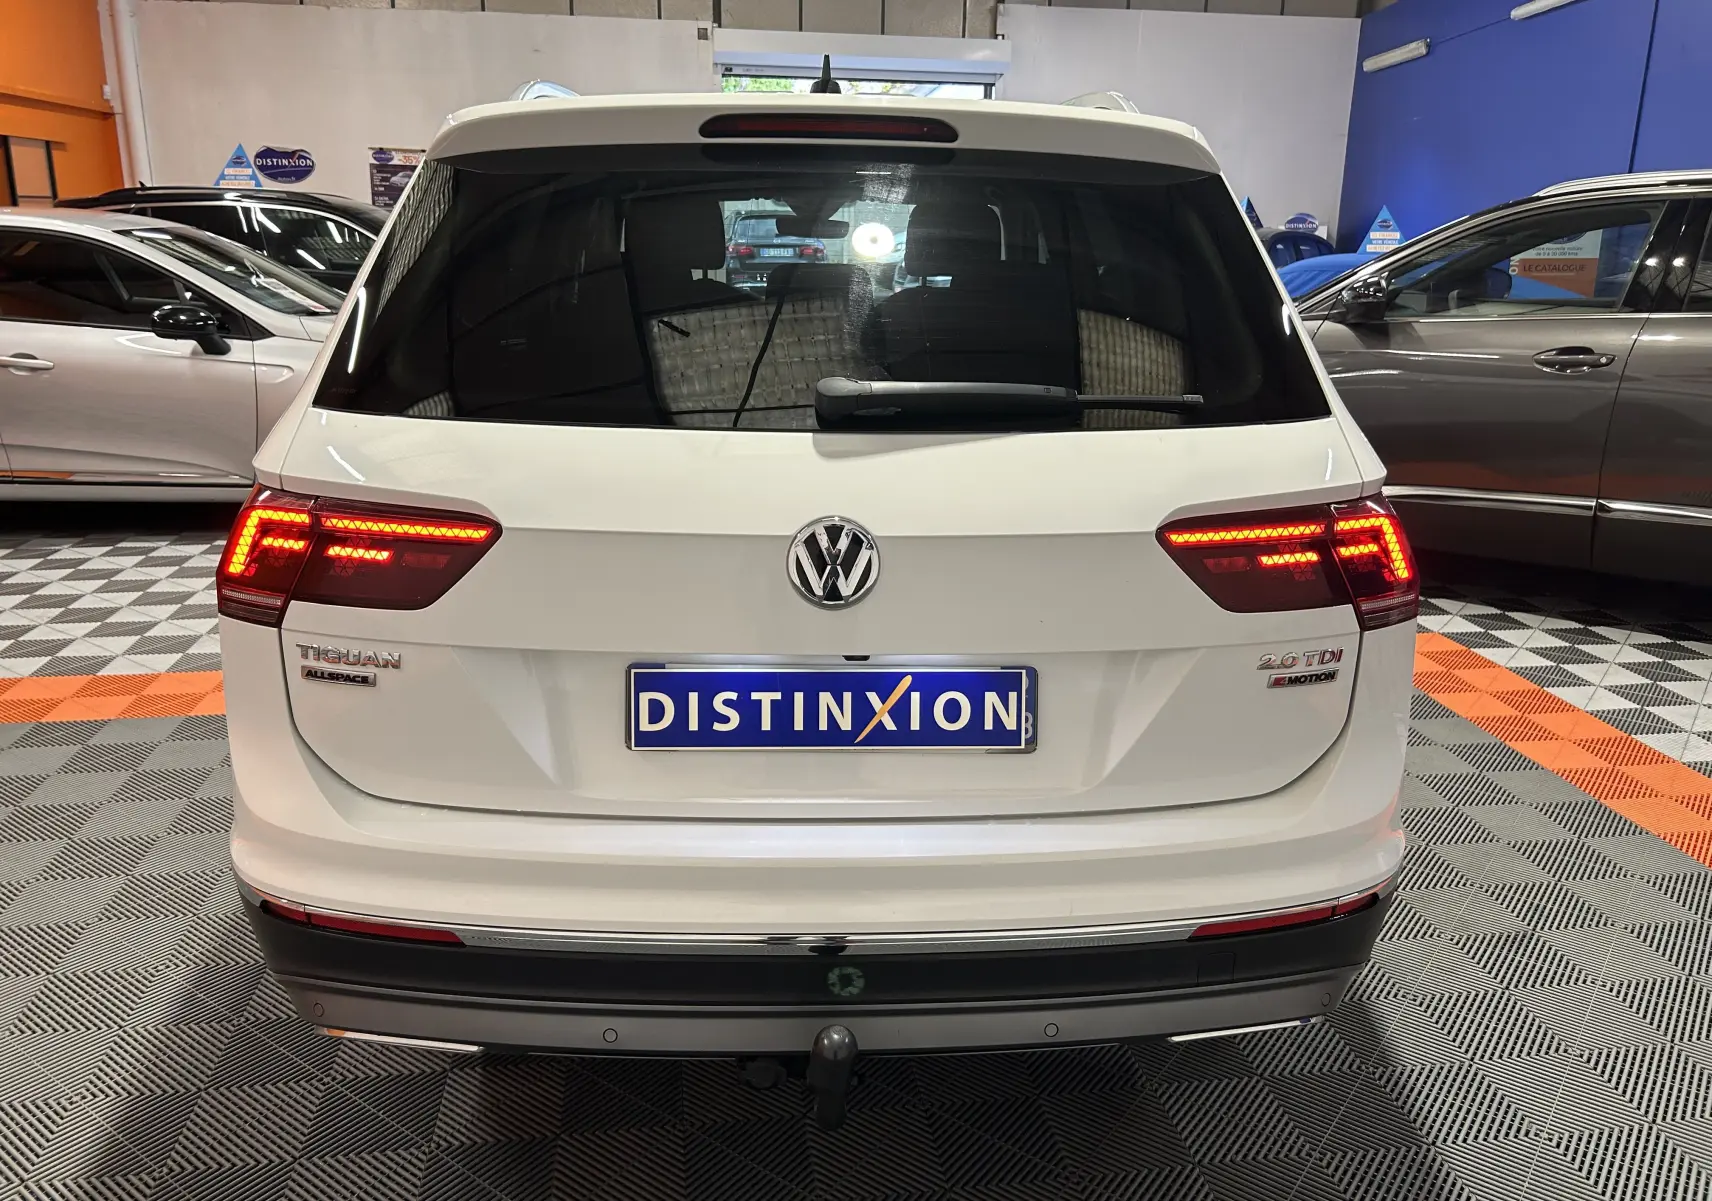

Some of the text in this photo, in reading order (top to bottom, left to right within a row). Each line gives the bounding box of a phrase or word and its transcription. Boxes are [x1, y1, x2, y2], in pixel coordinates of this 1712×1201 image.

[256, 156, 313, 167] DISTINXION
[1523, 264, 1587, 272] LE CATALOGUE
[296, 643, 401, 669] TIGUAN
[1257, 647, 1345, 670] 2.0 TDI
[305, 669, 370, 684] ALLSPACE
[638, 679, 1017, 740] DISTINXION
